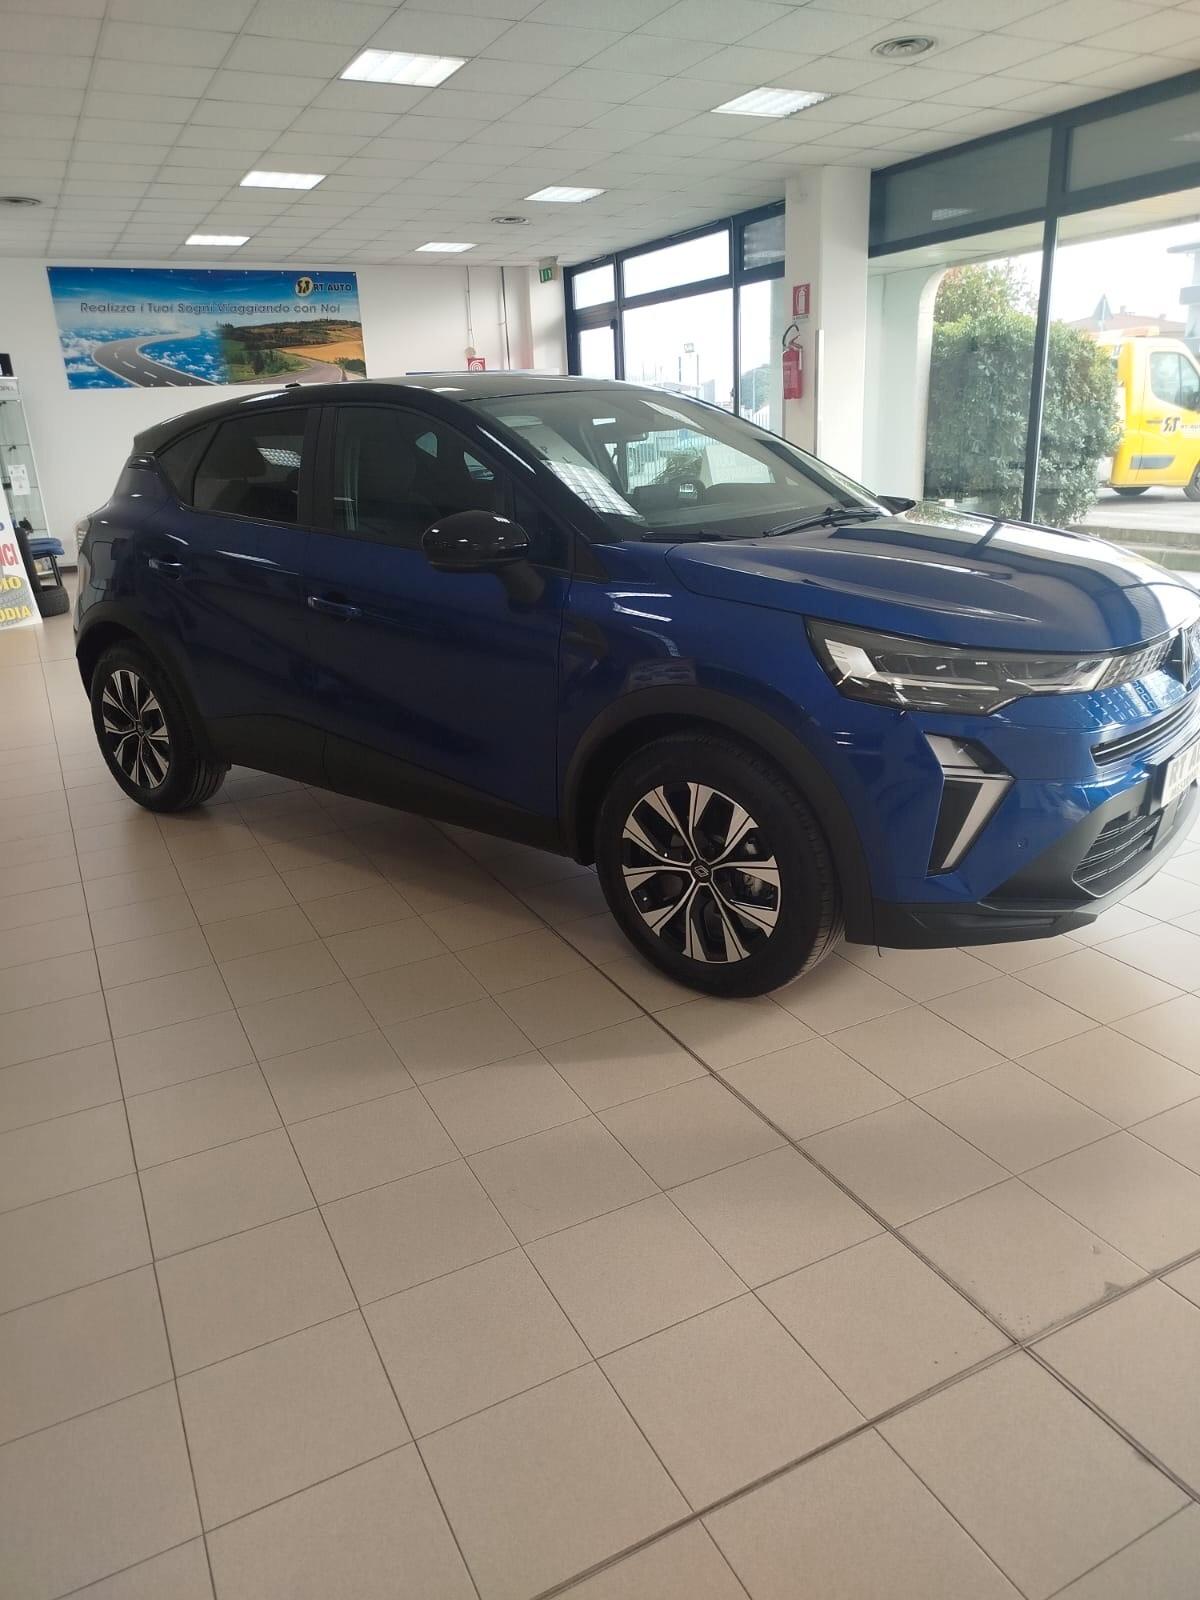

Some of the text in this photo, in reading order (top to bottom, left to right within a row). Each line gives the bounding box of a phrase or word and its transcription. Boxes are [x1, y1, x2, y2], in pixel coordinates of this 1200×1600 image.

[313, 282, 352, 291] RT AUTO
[80, 302, 341, 316] Realizza i Tuoi Sogni Viaggiando con Noi
